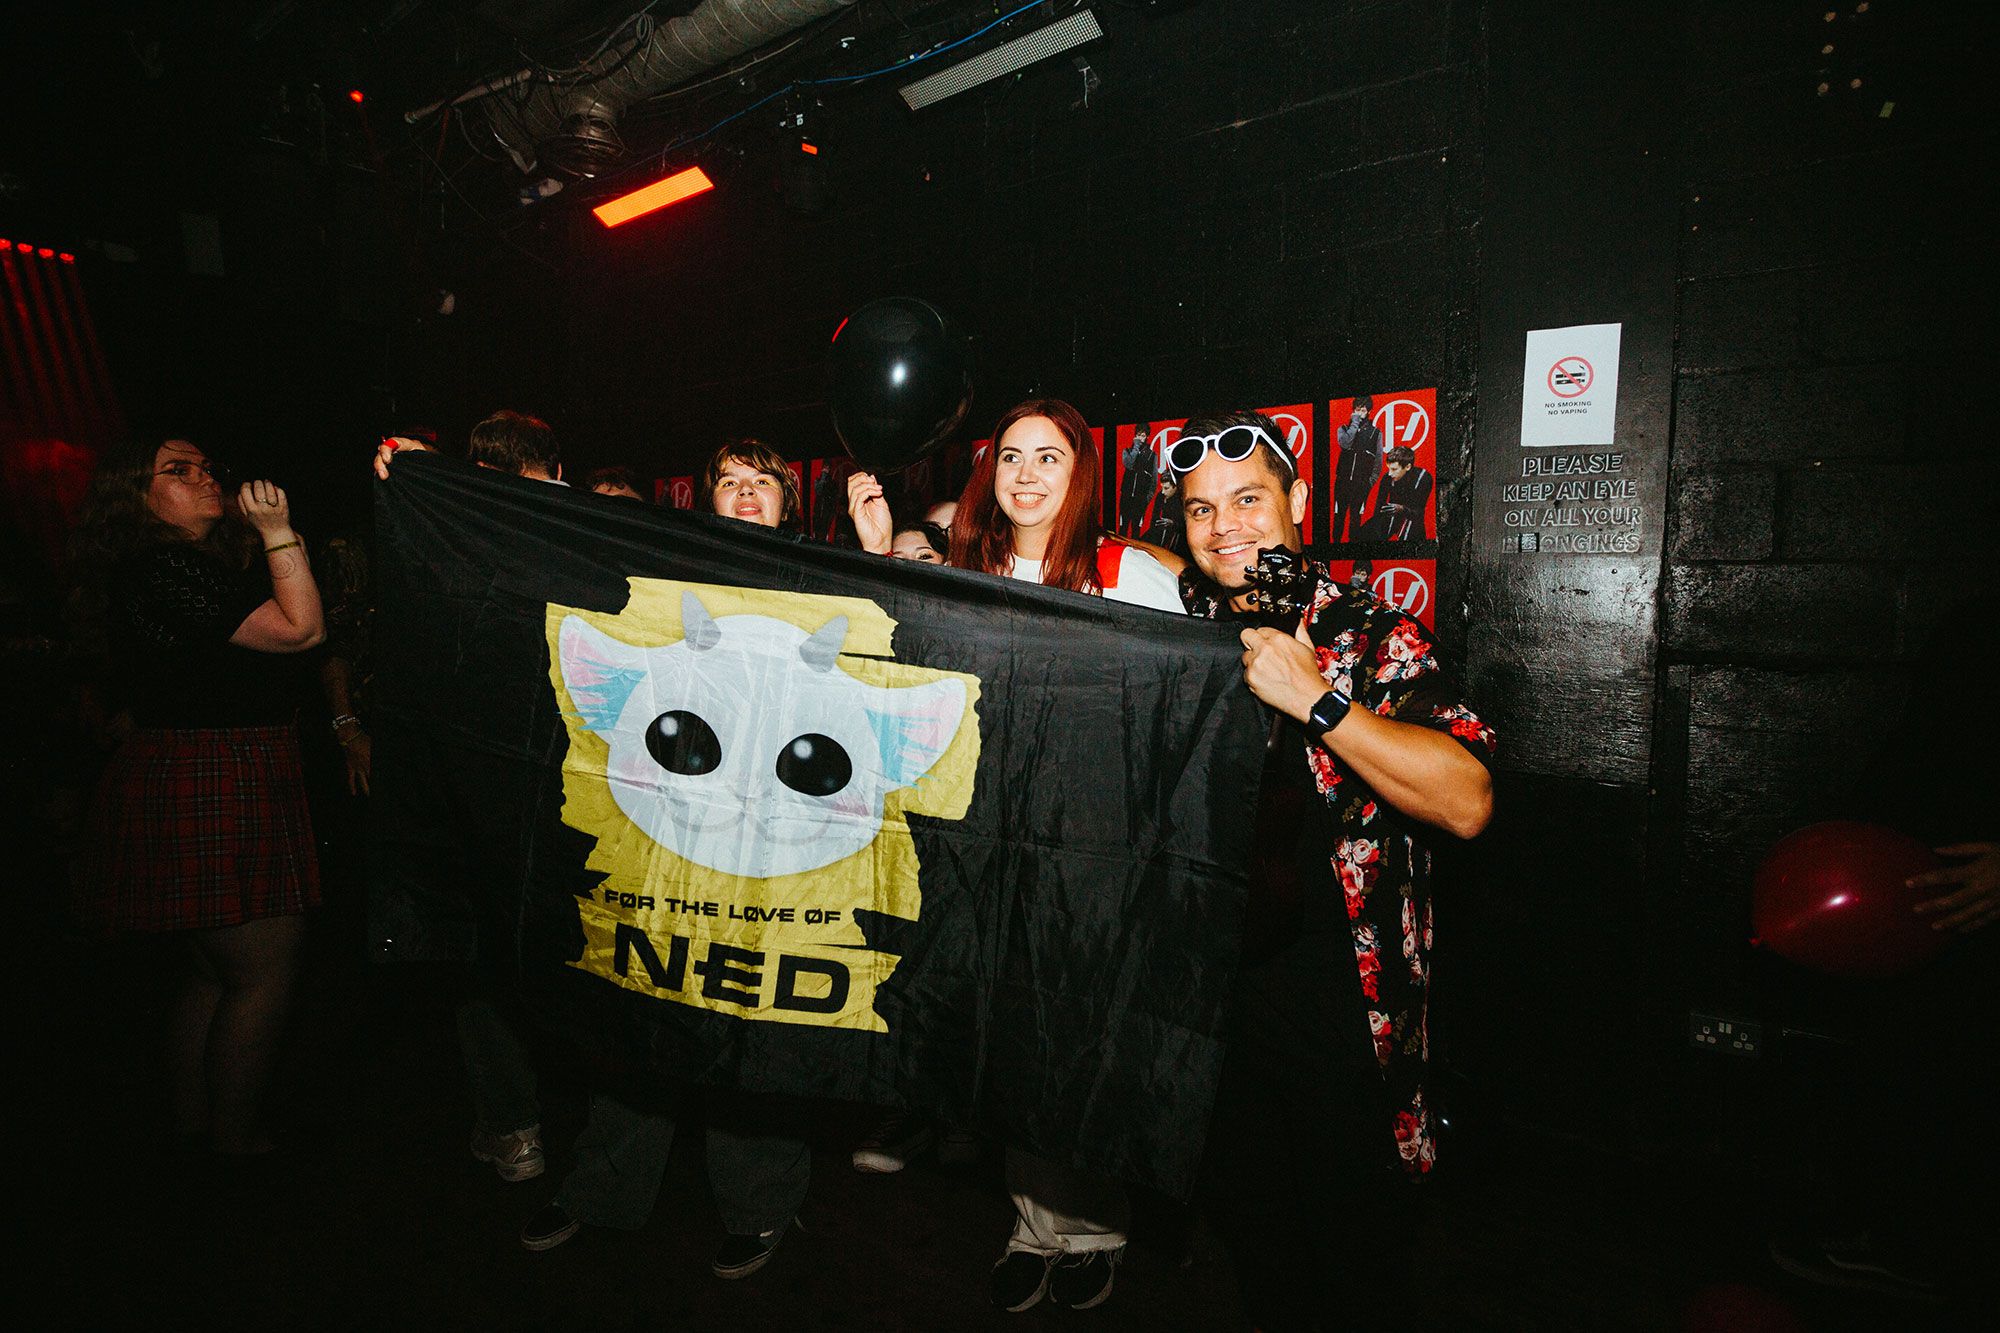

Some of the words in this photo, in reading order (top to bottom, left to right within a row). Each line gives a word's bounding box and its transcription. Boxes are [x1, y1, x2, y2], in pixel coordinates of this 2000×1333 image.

[1522, 453, 1623, 477] PLEASE
[1502, 482, 1555, 502] KEEP
[1556, 481, 1590, 500] AN
[1594, 479, 1637, 499] EYE
[1504, 509, 1538, 527] ON
[1541, 507, 1580, 526] ALL
[1581, 506, 1642, 526] YOUR
[1502, 533, 1641, 554] BONGINGS
[664, 897, 720, 918] THE
[613, 921, 851, 1015] NED
